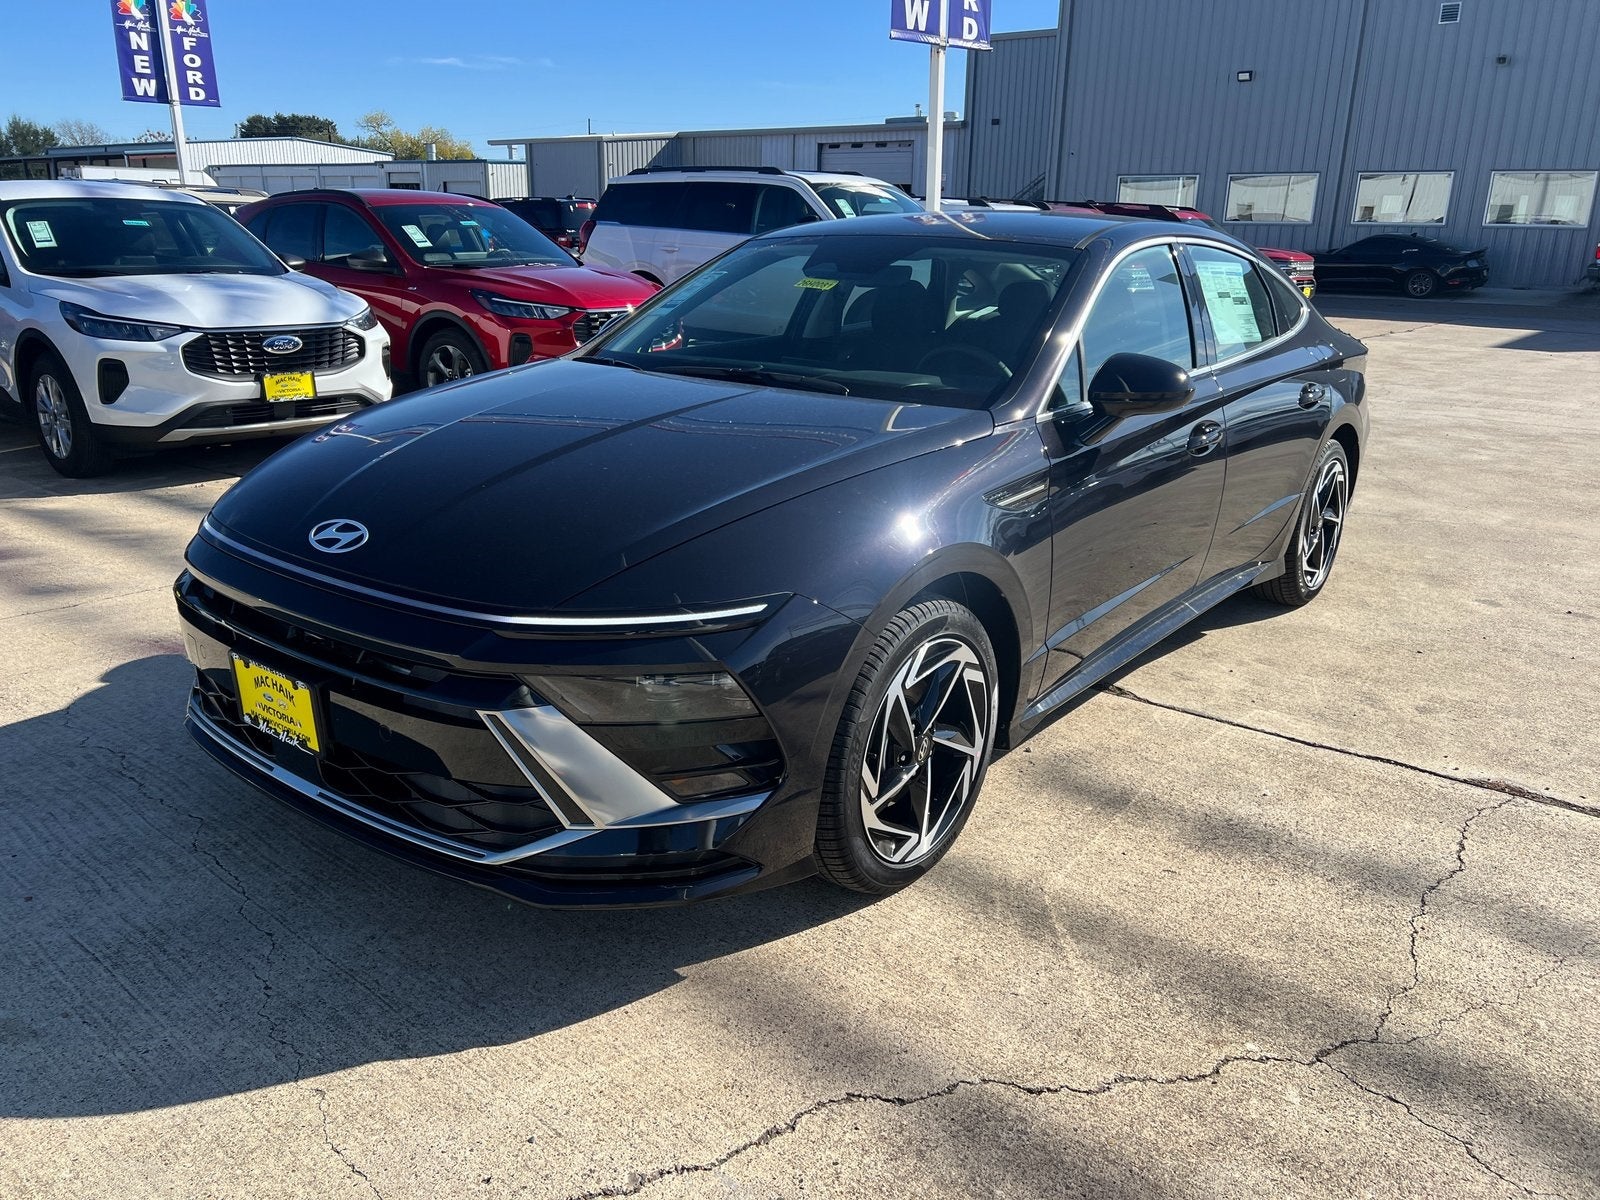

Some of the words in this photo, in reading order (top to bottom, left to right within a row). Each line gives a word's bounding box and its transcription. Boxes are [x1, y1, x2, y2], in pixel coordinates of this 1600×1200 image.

[129, 31, 157, 97] NEW
[182, 36, 206, 101] FORD
[272, 339, 295, 350] Ford
[254, 675, 271, 690] MAC
[271, 678, 297, 707] HAIK
[259, 702, 296, 727] VICTORIA
